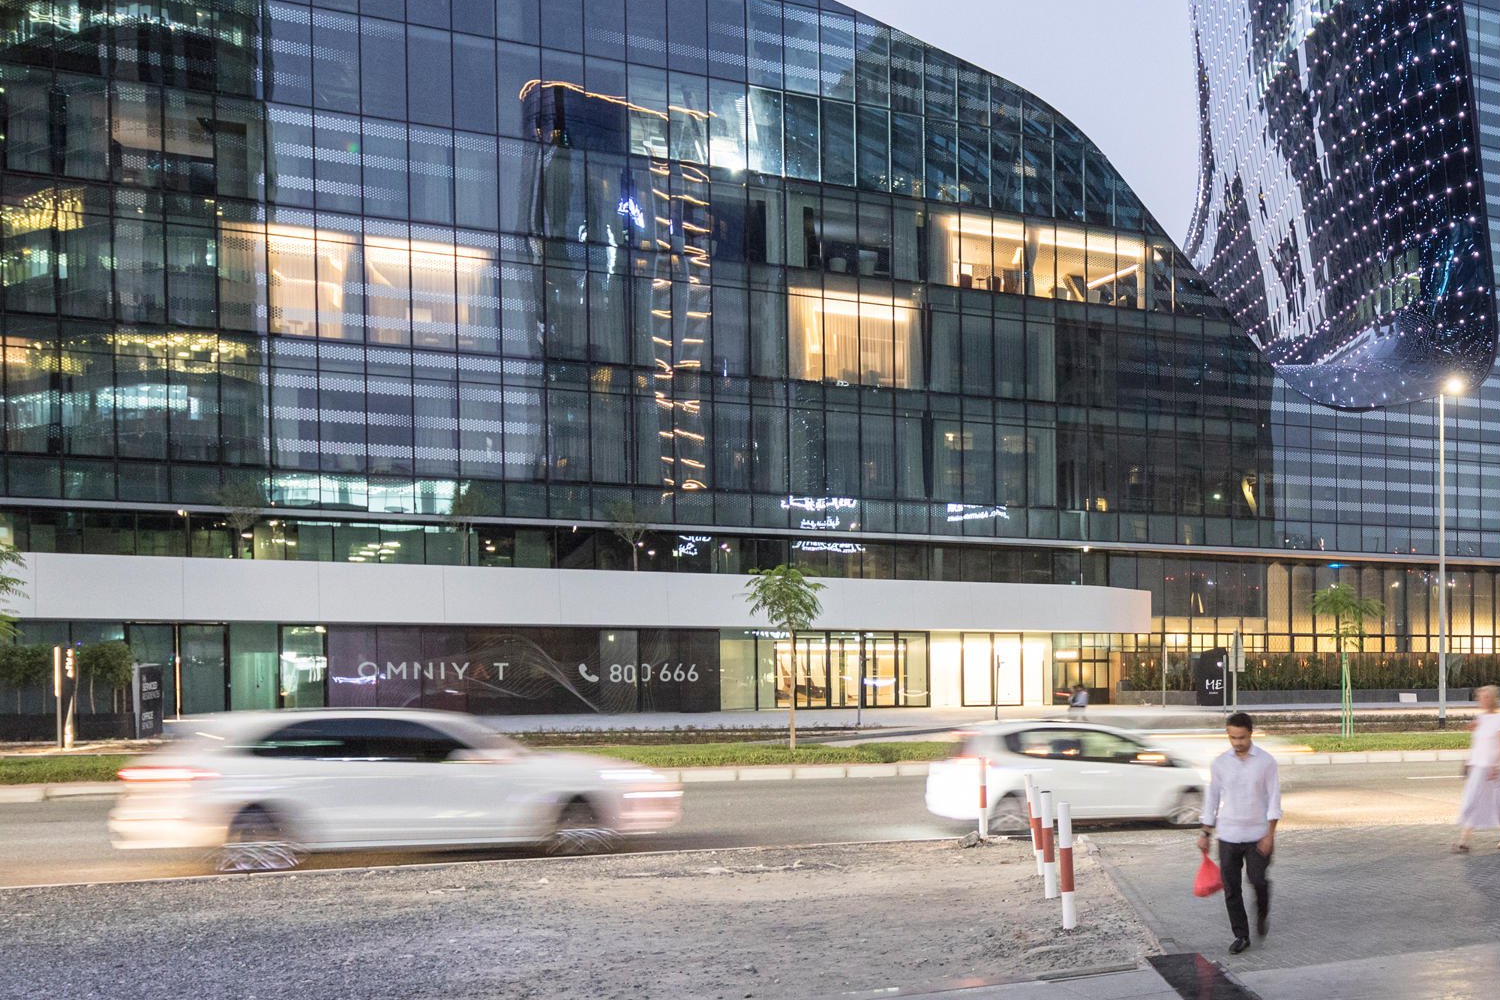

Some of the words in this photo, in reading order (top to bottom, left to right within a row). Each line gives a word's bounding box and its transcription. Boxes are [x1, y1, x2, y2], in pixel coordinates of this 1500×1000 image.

[357, 661, 509, 681] OMNIYAT
[609, 663, 652, 683] 800
[659, 663, 699, 682] 666
